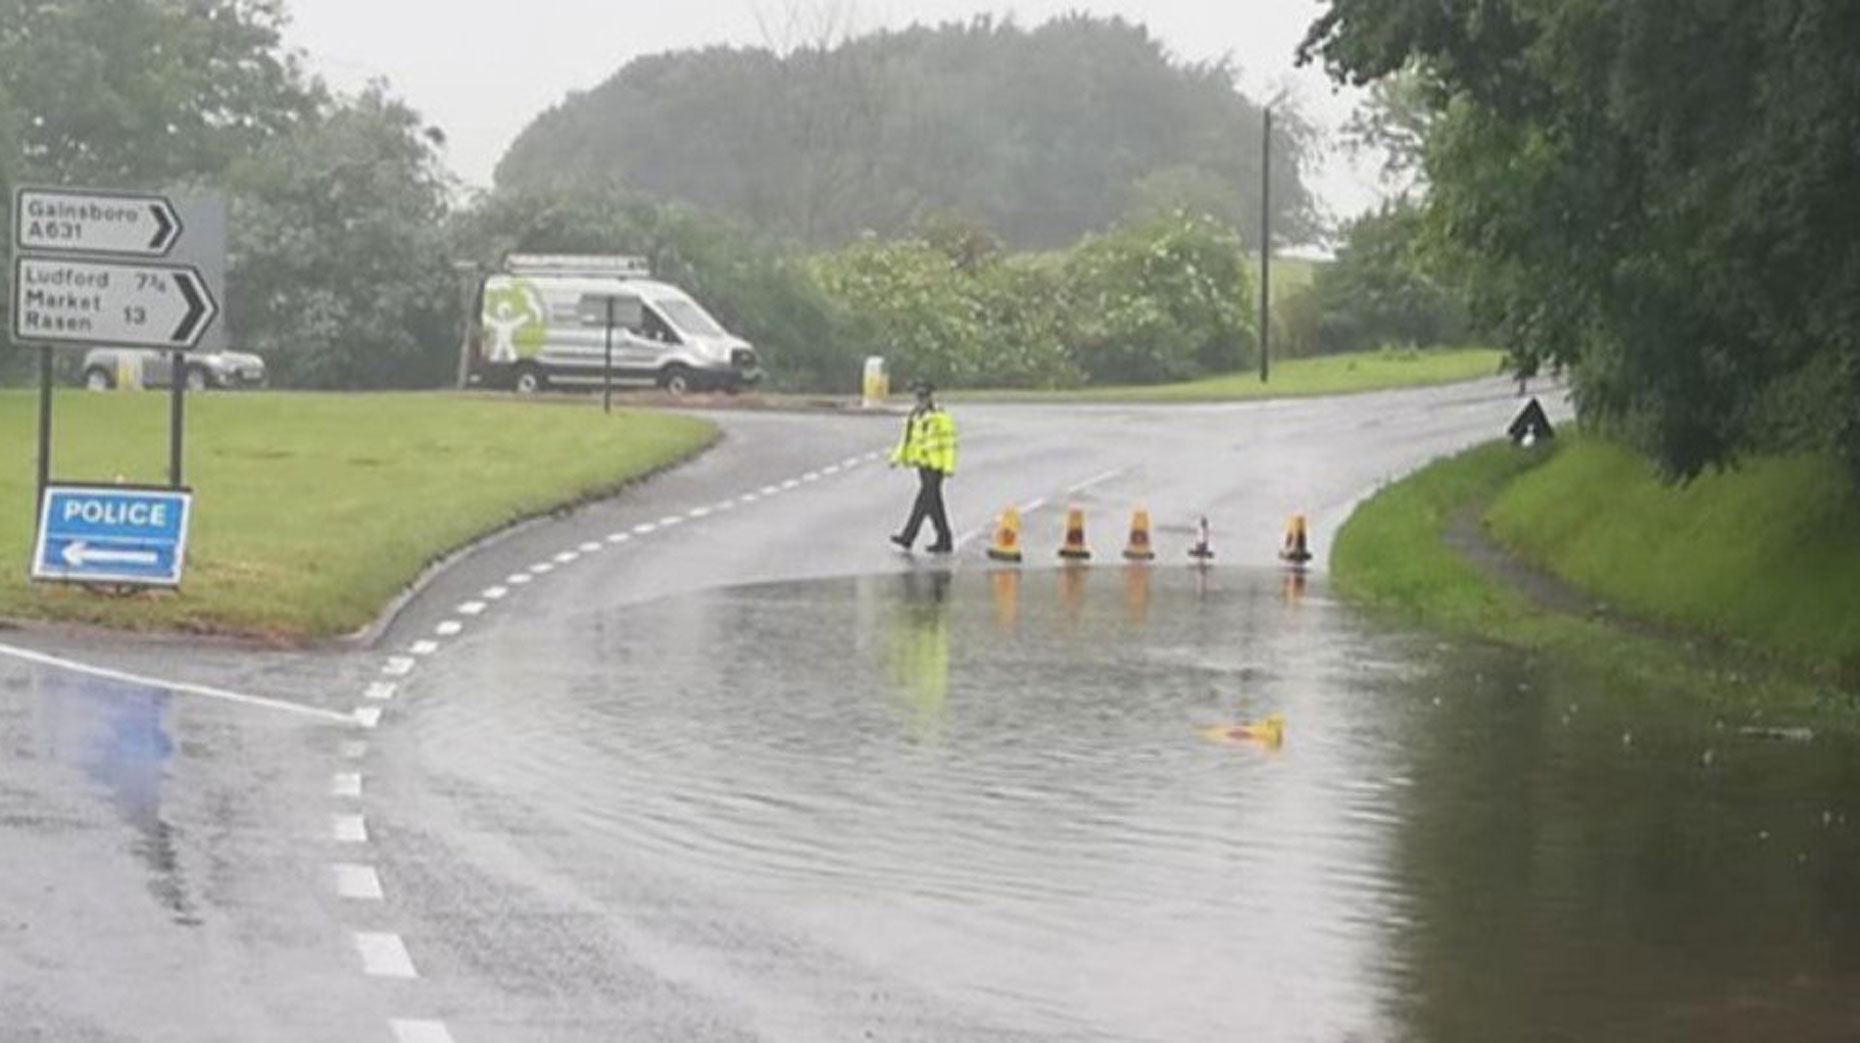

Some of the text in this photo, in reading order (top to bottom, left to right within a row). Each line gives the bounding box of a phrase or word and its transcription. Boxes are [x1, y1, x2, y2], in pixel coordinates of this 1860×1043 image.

[28, 200, 138, 223] Gainsboro
[28, 221, 82, 239] A631
[26, 267, 109, 288] Ludford
[26, 289, 101, 311] Market
[26, 310, 92, 330] Rasen
[124, 306, 146, 324] 13
[64, 500, 167, 527] POLICE
